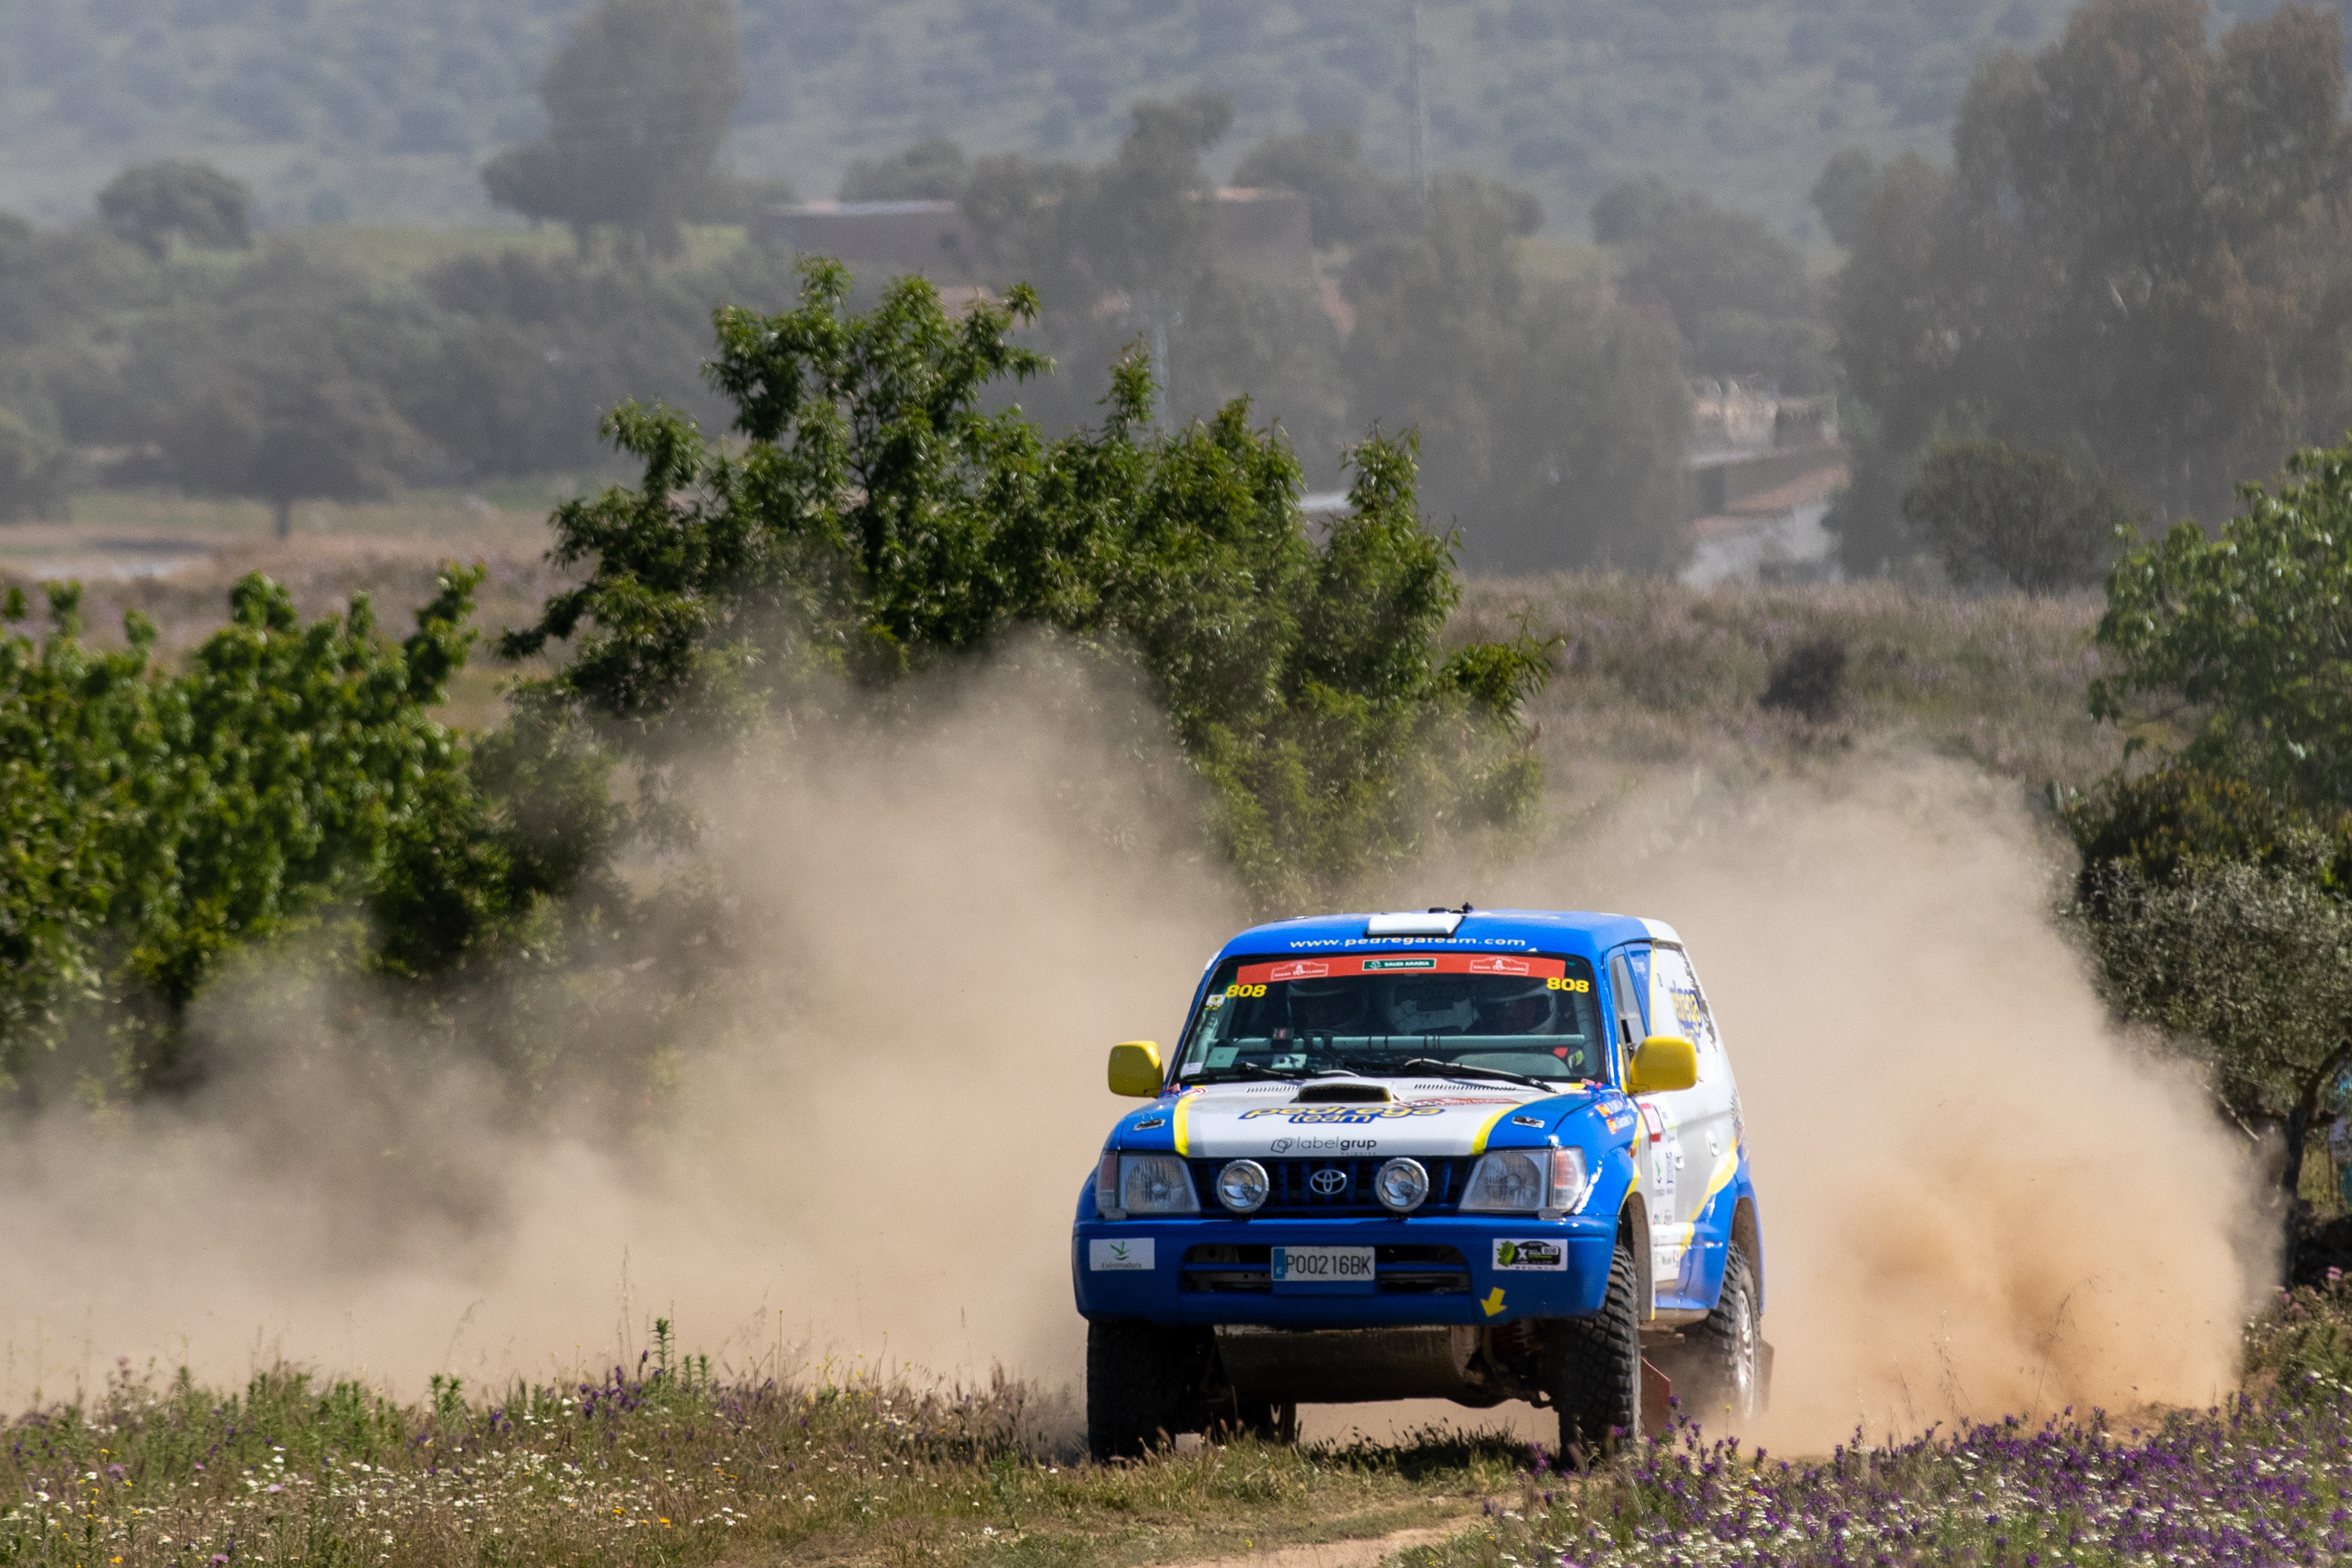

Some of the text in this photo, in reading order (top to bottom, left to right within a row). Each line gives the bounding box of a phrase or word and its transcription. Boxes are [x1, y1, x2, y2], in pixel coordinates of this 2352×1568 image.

[1225, 984, 1267, 997] 808
[1547, 977, 1589, 993] 808
[1241, 1106, 1444, 1118] pedrega
[1292, 1113, 1371, 1123] team
[1297, 1136, 1378, 1151] labelgrup
